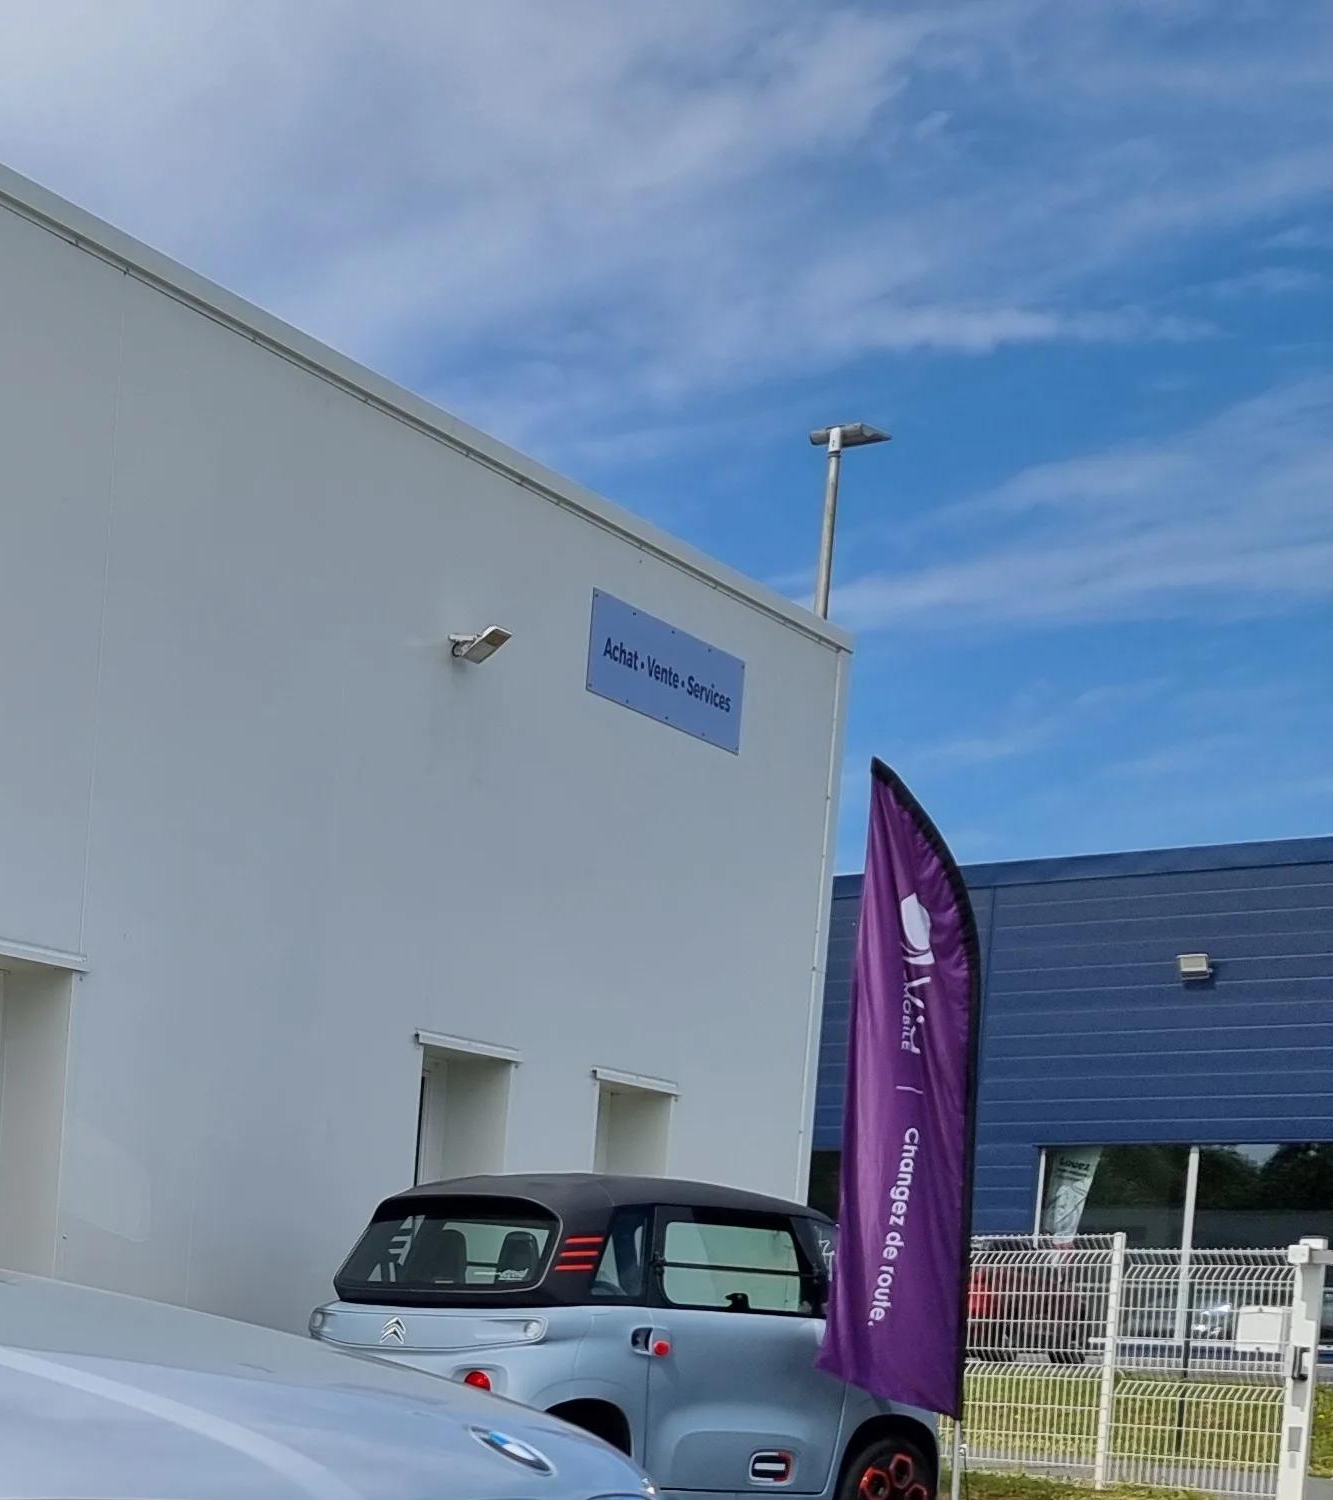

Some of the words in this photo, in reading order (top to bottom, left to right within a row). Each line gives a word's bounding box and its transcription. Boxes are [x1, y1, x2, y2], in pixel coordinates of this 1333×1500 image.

[603, 637, 638, 671] Achat
[646, 655, 680, 689] Vente
[687, 676, 732, 713] Services
[889, 1127, 920, 1226] Changez
[883, 1231, 906, 1260] de
